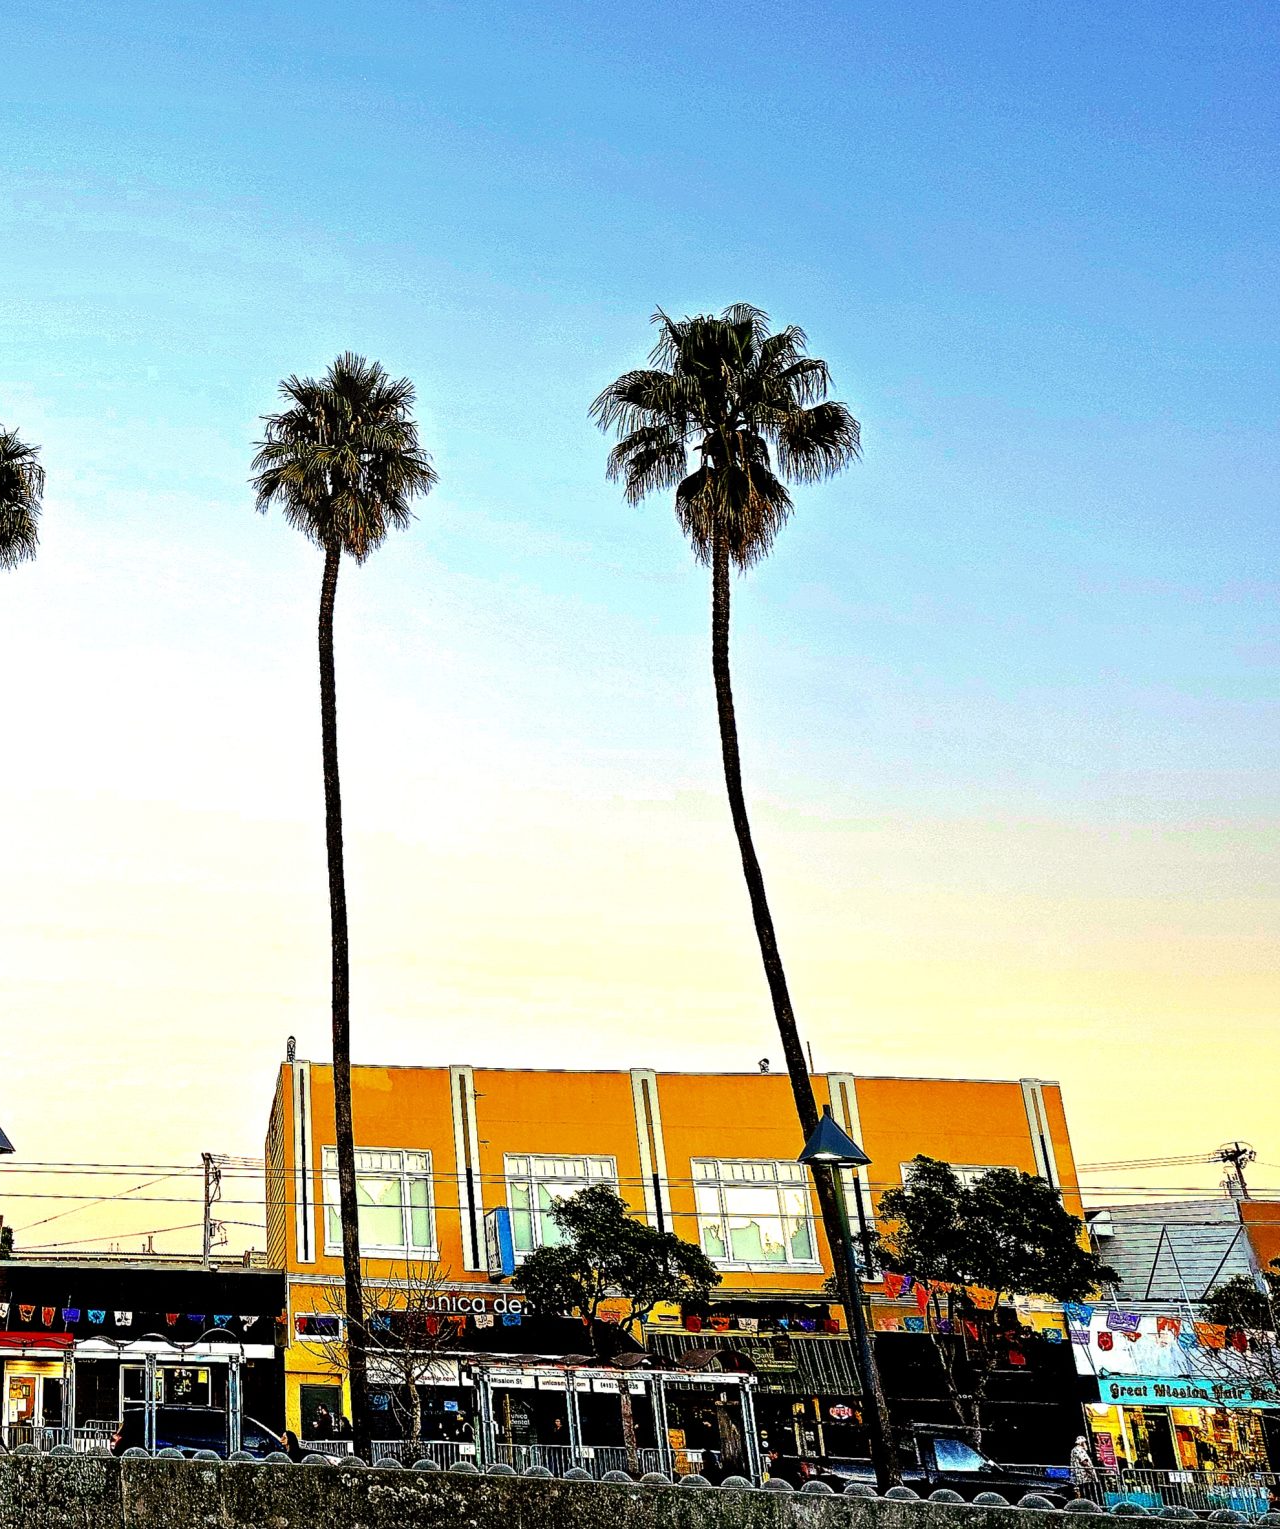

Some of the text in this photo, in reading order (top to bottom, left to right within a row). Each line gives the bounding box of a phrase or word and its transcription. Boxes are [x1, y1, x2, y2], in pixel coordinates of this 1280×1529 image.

[425, 1295, 487, 1314] unica
[490, 1377, 515, 1385] Mission
[1109, 1383, 1148, 1399] Great
[1153, 1384, 1209, 1399] Mission
[829, 1407, 853, 1417] OPEN
